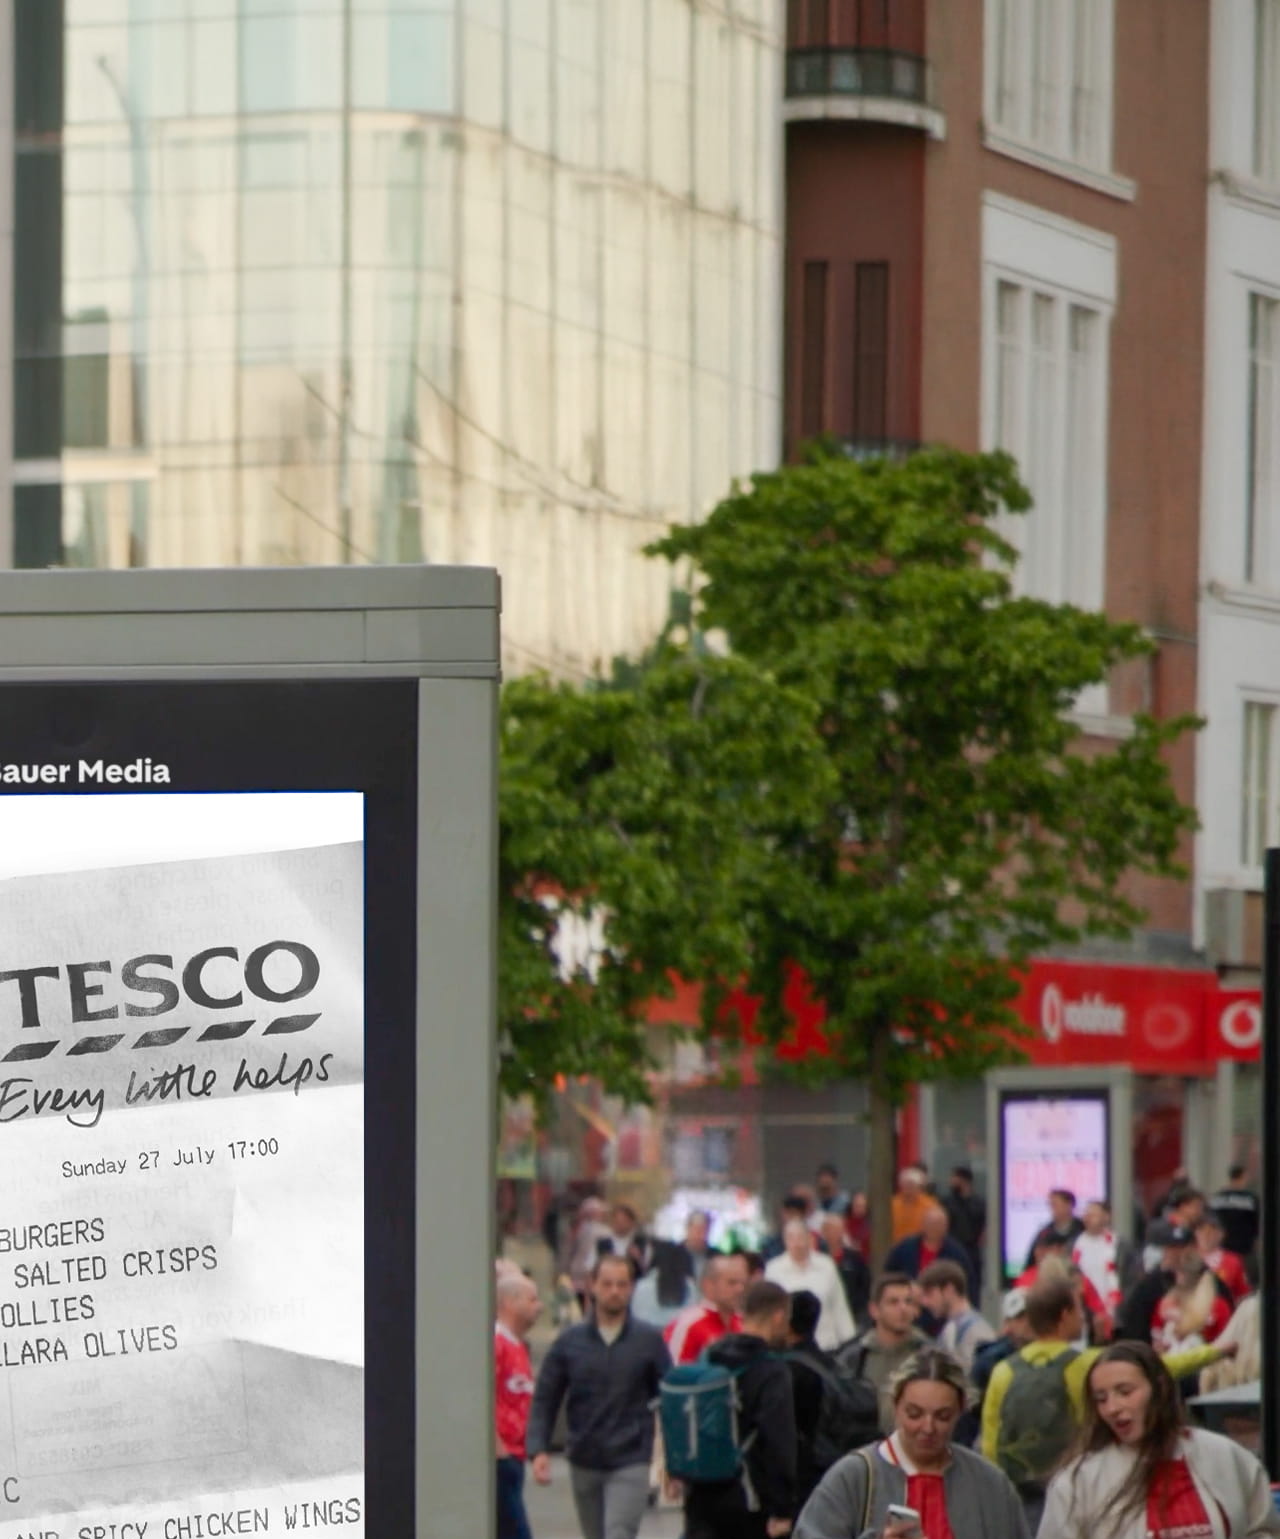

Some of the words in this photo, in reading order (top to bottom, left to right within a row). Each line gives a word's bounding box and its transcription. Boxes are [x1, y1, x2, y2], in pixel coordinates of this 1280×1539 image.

[77, 758, 172, 784] Media
[125, 1063, 217, 1105] little
[232, 1051, 334, 1097] helps
[61, 1157, 127, 1179] Sunday
[138, 1150, 160, 1170] 27
[172, 1146, 215, 1167] July
[227, 1137, 279, 1160] 17:00
[13, 1255, 107, 1289] SALTED
[122, 1244, 218, 1278] CRISPS
[83, 1324, 178, 1359] OLIVES
[284, 1497, 362, 1530] WINGS
